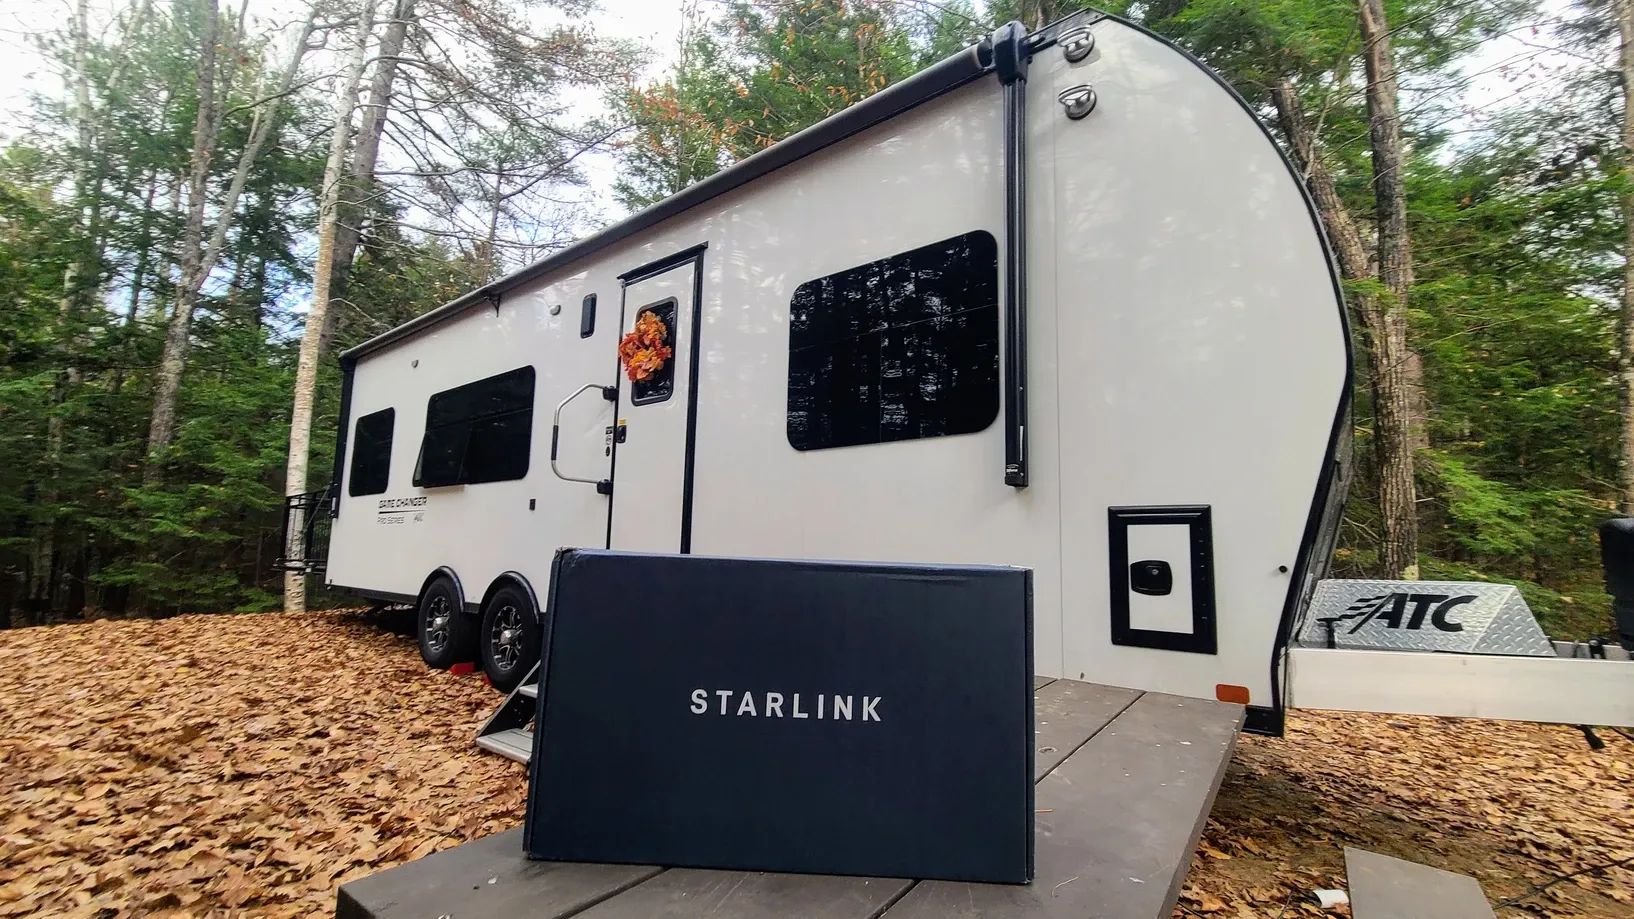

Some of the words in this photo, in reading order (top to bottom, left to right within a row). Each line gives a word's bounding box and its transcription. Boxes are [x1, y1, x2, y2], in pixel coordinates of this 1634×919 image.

[379, 499, 397, 509] GAME
[397, 496, 428, 507] CHANGER
[1347, 592, 1479, 633] ATC
[690, 688, 882, 722] STARLINK
